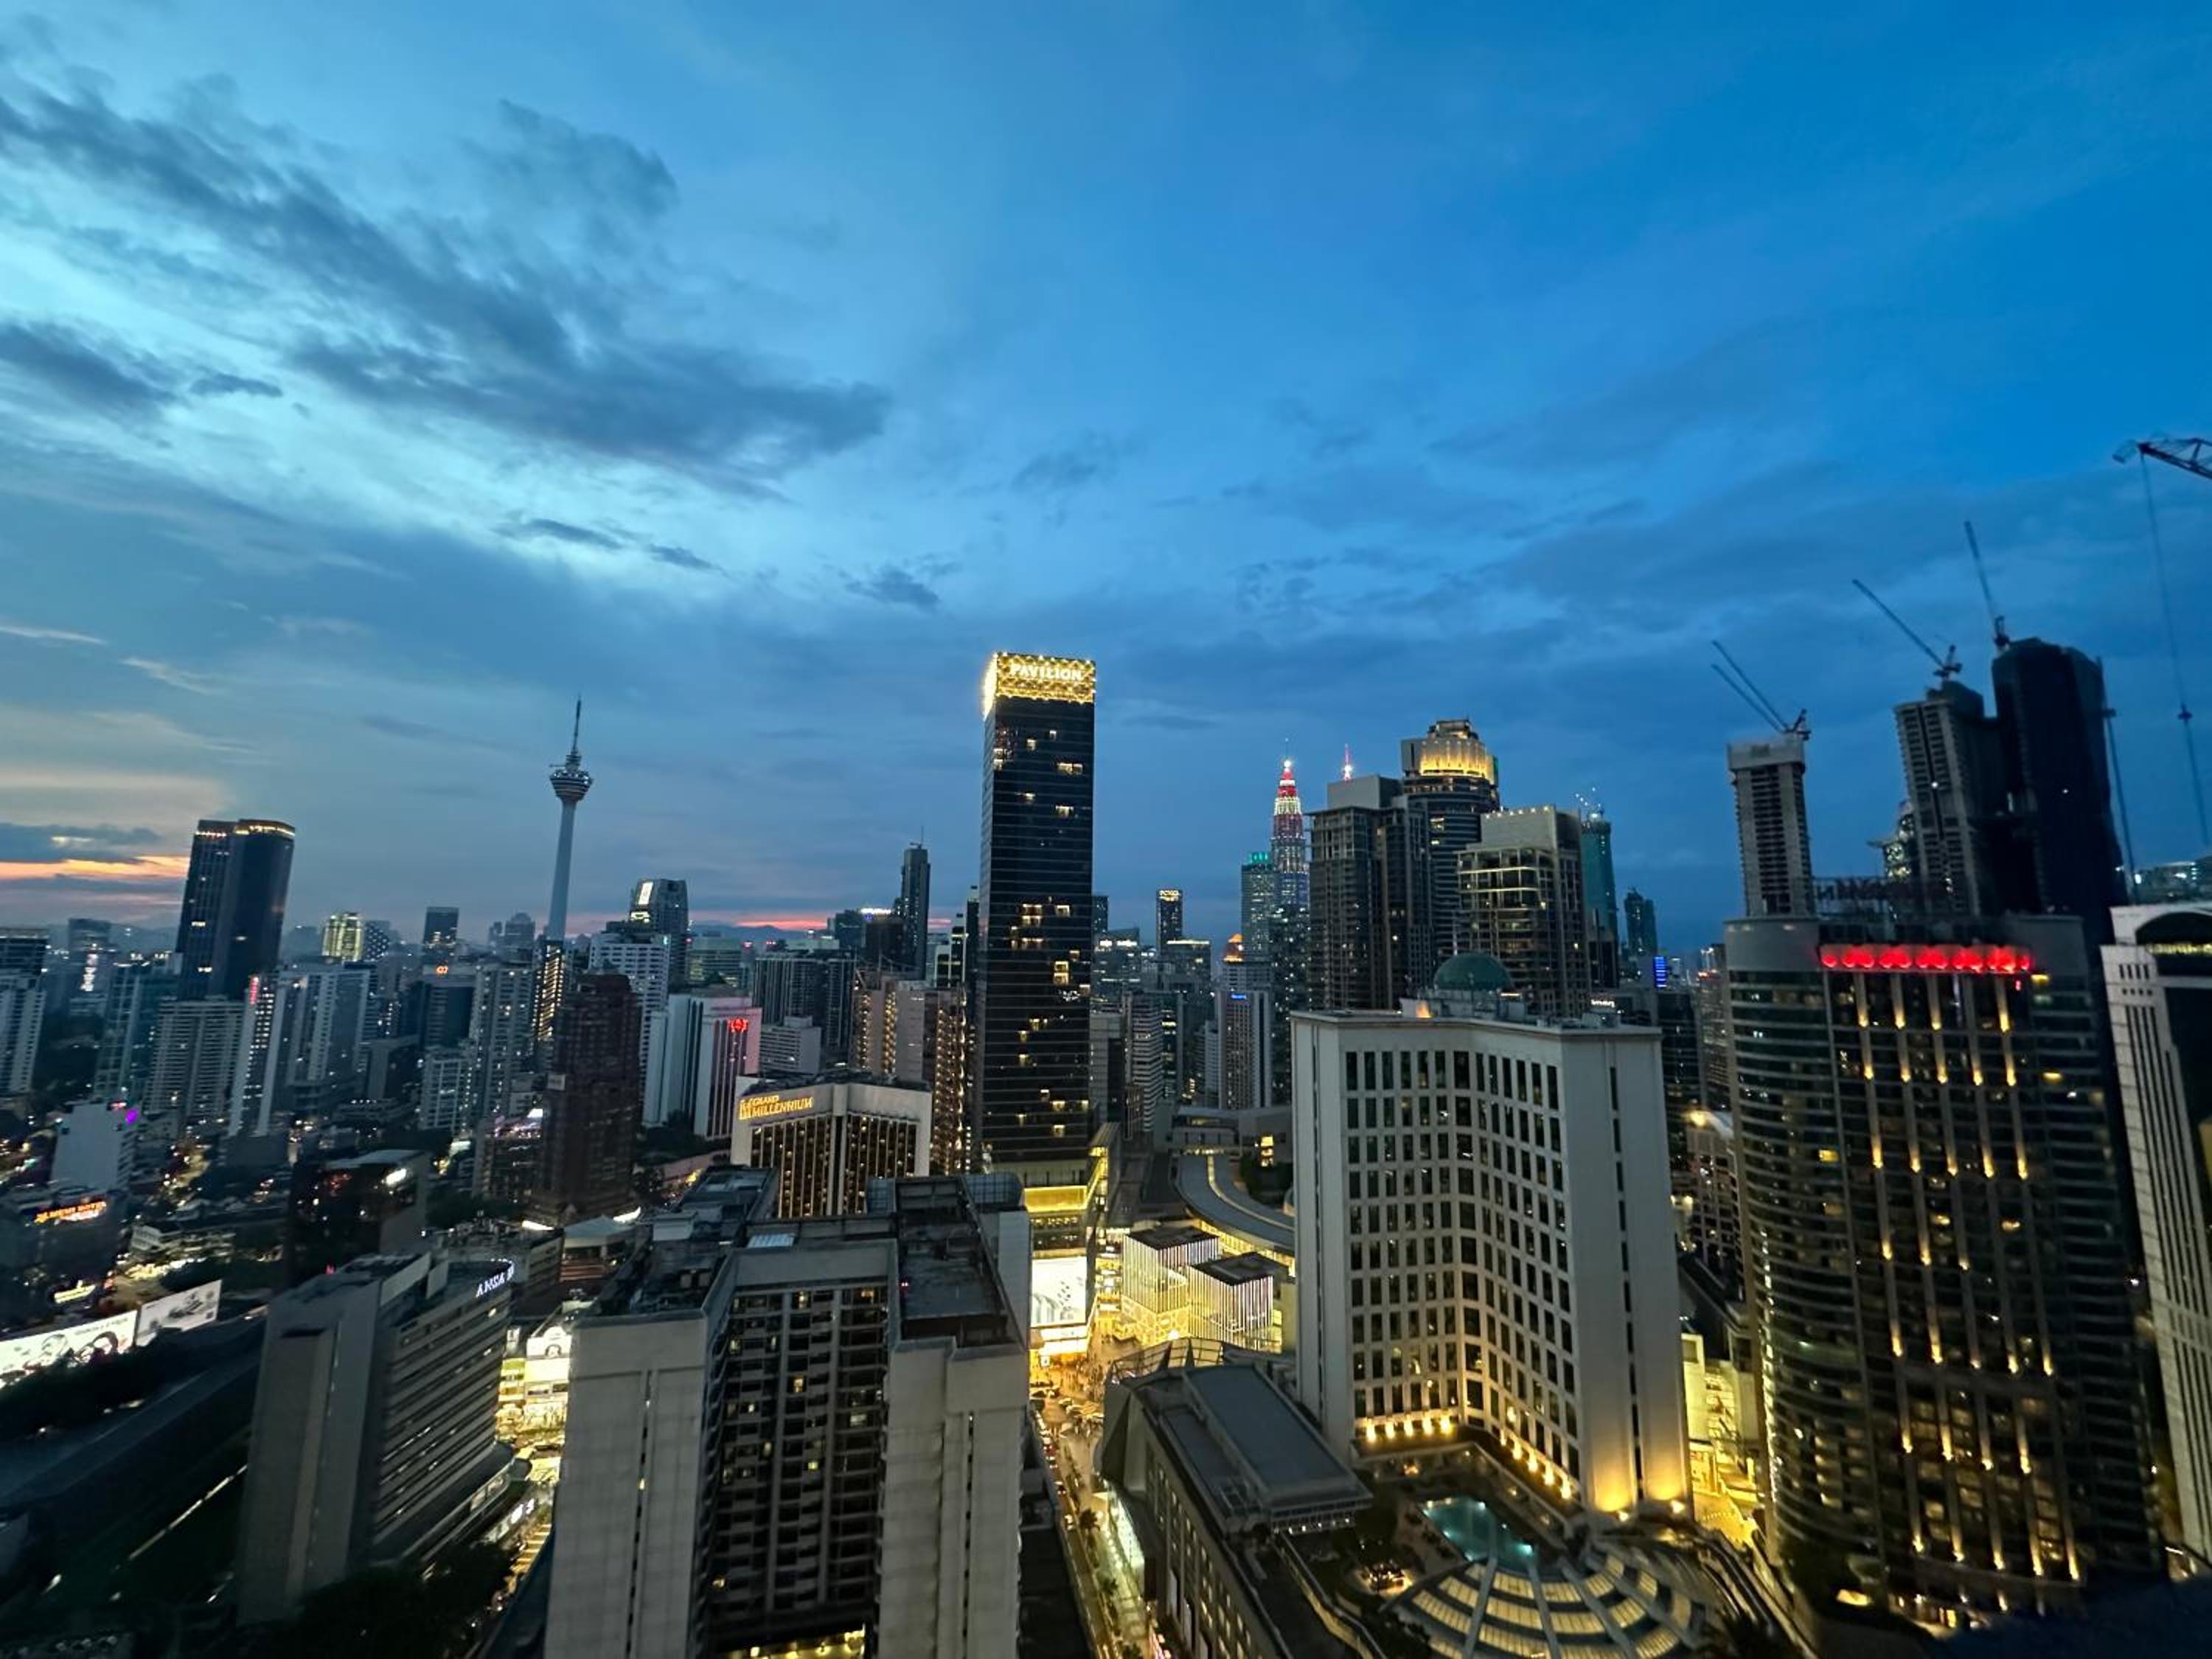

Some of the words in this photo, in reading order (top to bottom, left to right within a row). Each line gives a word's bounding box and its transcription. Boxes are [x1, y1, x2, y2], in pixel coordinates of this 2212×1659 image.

[1010, 663, 1082, 681] PAVILION
[751, 1096, 814, 1118] MILLENNIUM
[753, 1095, 779, 1106] GRAND
